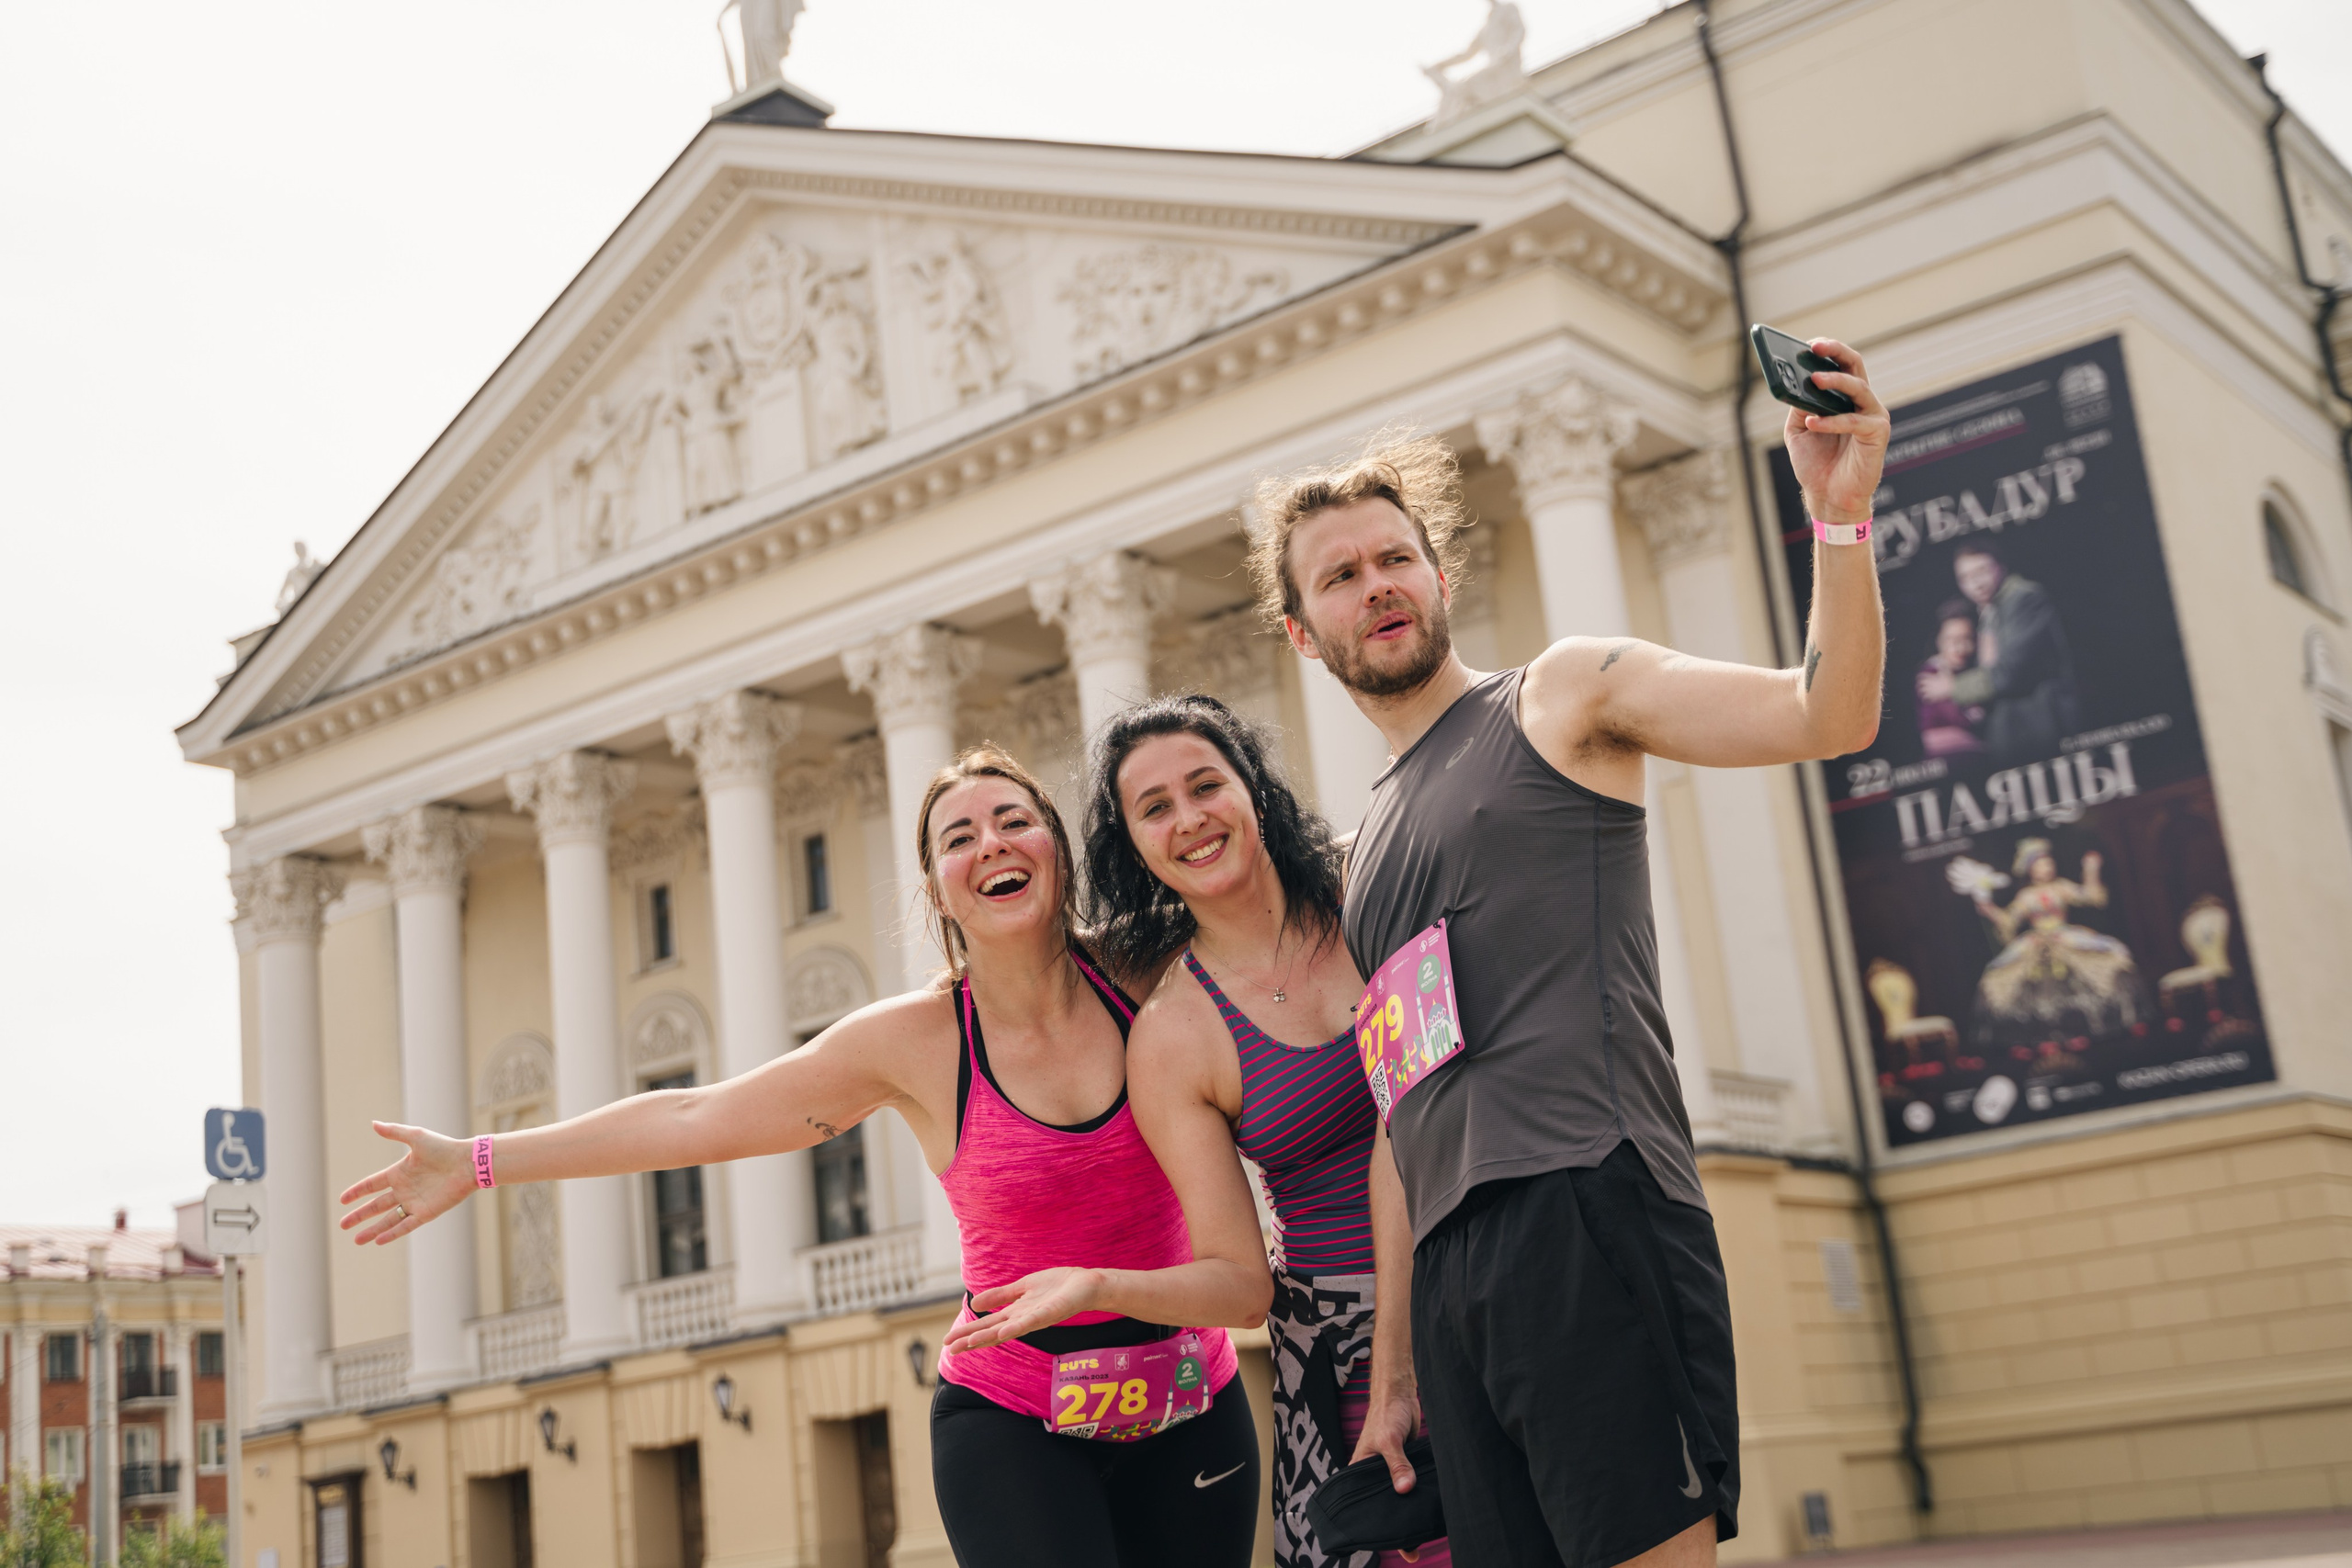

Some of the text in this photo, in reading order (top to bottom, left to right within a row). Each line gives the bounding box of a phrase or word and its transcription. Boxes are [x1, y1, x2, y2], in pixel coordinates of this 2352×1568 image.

[1869, 457, 2086, 559] РУБАДУР
[1847, 758, 1893, 798] 22
[1894, 742, 2142, 848] ПАЯЦЫ
[1422, 961, 1434, 980] 2
[1360, 994, 1405, 1077] 279
[477, 1134, 492, 1189] ЗАВТР
[1058, 1358, 1100, 1373] RUTS
[1058, 1372, 1110, 1383] КАЗАНЬ 2023
[1178, 1376, 1198, 1386] ВОЛНА
[1182, 1362, 1193, 1379] 2
[1056, 1378, 1148, 1427] 278
